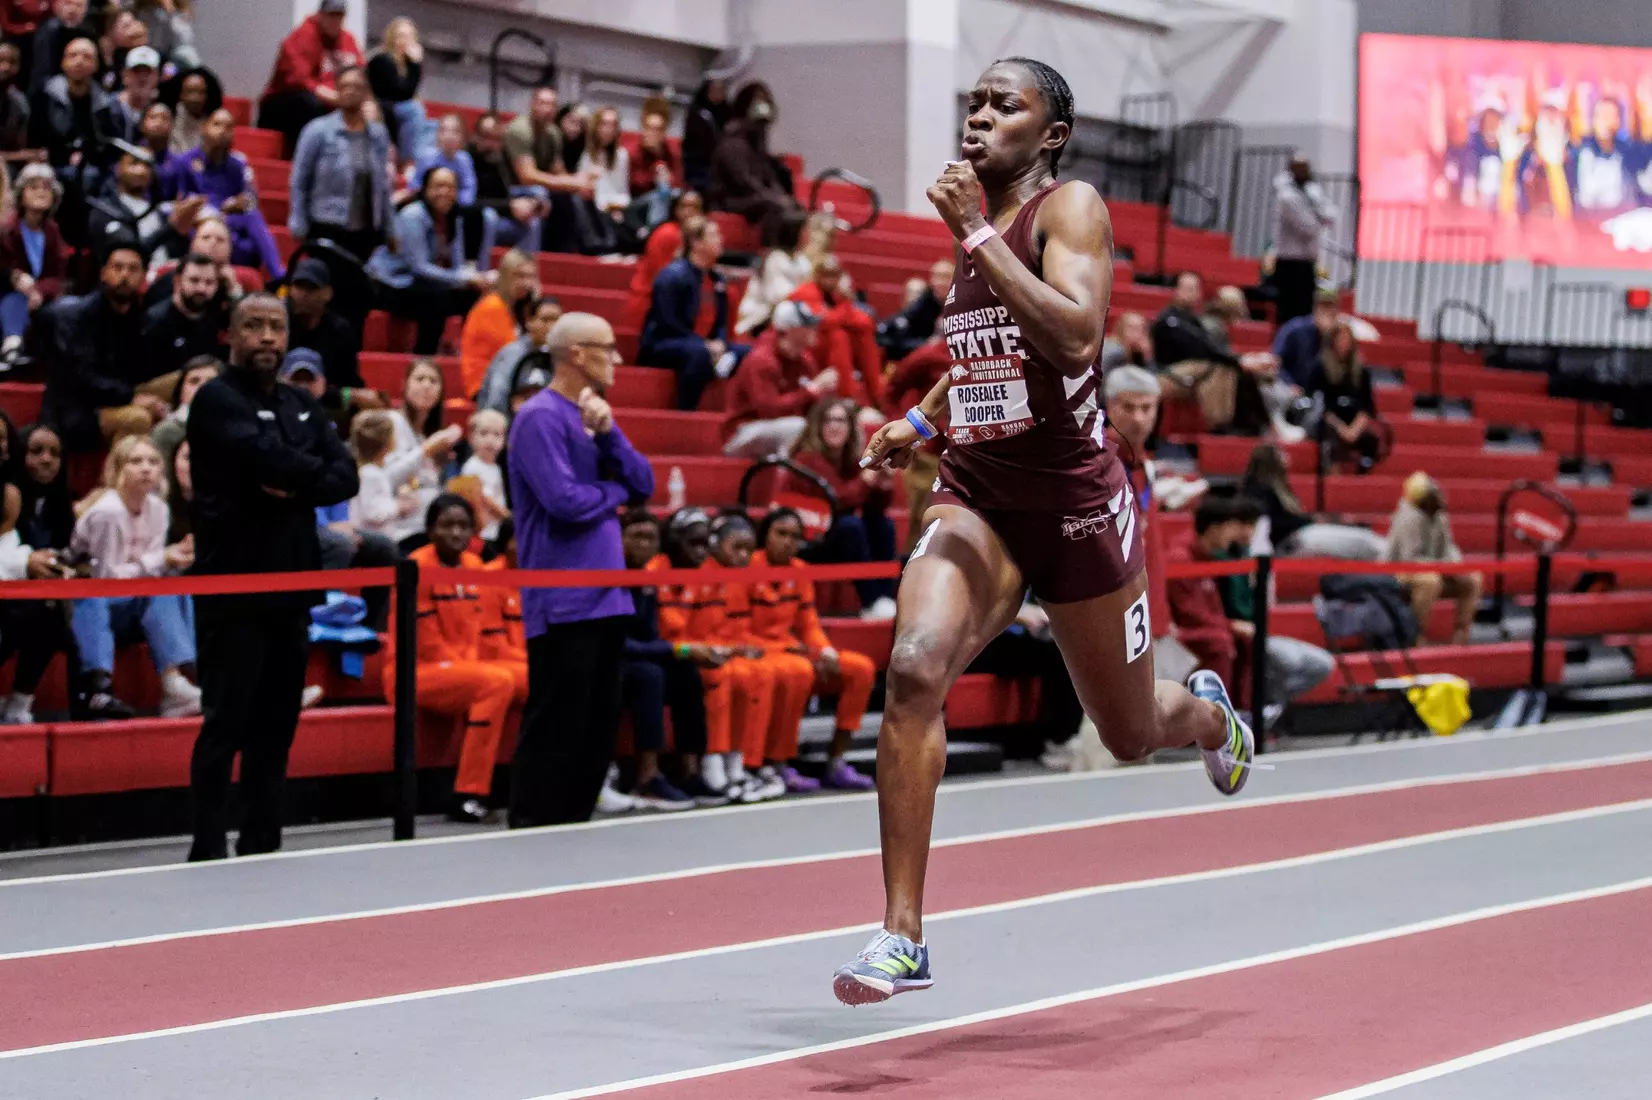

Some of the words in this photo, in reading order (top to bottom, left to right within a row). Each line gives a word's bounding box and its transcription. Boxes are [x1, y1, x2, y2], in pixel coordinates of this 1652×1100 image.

[943, 306, 1015, 335] MISSISSIPP
[946, 326, 1026, 360] STATE
[970, 358, 1012, 371] RAZORBACK
[972, 368, 1021, 381] INVITATIONAL
[957, 384, 1009, 404] ROSEALEE
[964, 404, 1006, 423] COOPER
[1131, 603, 1146, 656] 3
